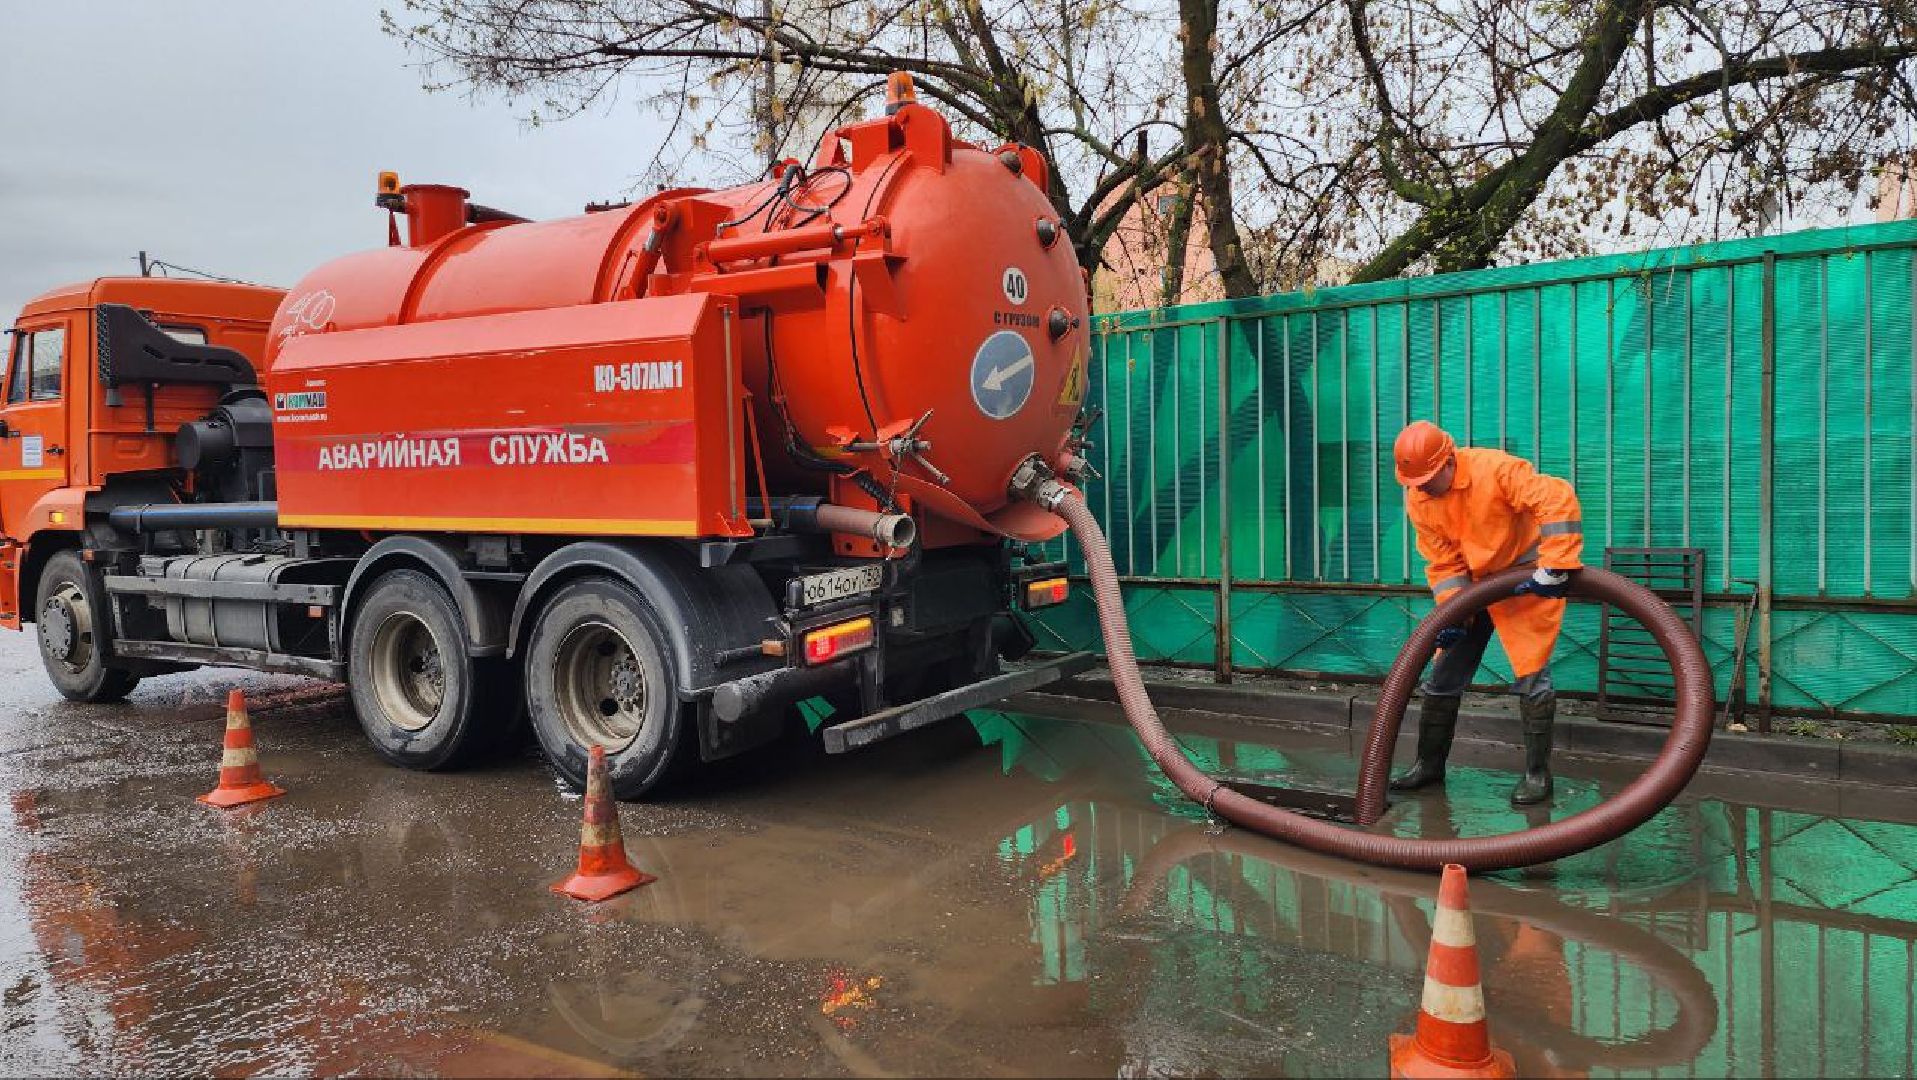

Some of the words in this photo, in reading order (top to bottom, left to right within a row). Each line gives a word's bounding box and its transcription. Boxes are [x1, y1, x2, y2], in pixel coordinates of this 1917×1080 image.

[1006, 274, 1025, 299] 40
[994, 310, 1001, 324] С
[1003, 312, 1040, 328] ГРУЗОМ
[318, 433, 461, 470] АВАРИЙНАЯ
[489, 432, 609, 465] СЛУЖБА
